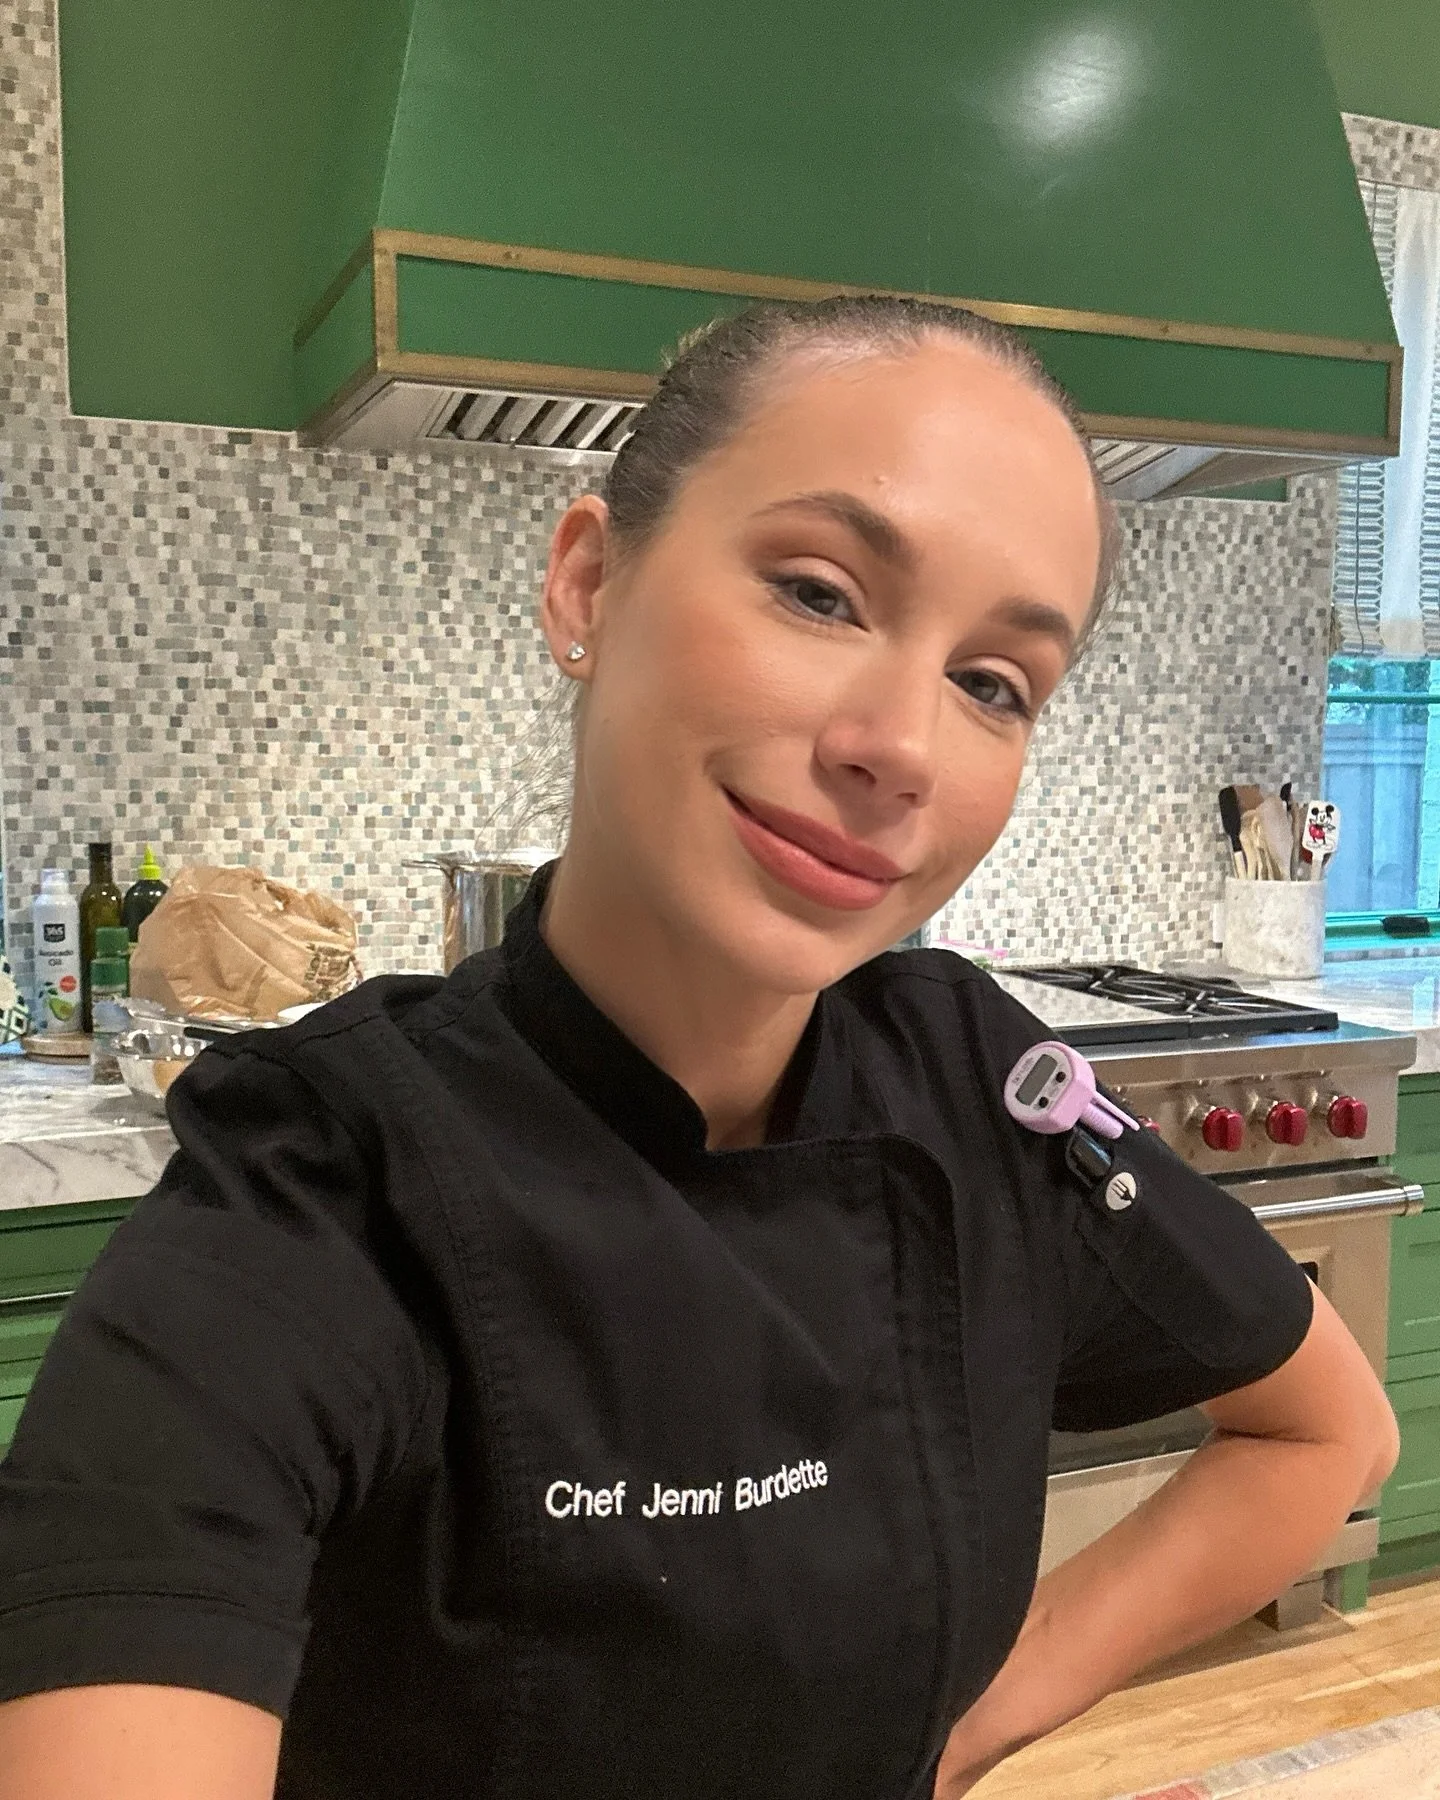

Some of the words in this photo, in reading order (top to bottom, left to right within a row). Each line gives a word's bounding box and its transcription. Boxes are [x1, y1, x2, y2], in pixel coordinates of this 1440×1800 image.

[544, 1480, 627, 1519] Chef
[641, 1481, 724, 1519] Jenni
[734, 1458, 829, 1511] Burdette
